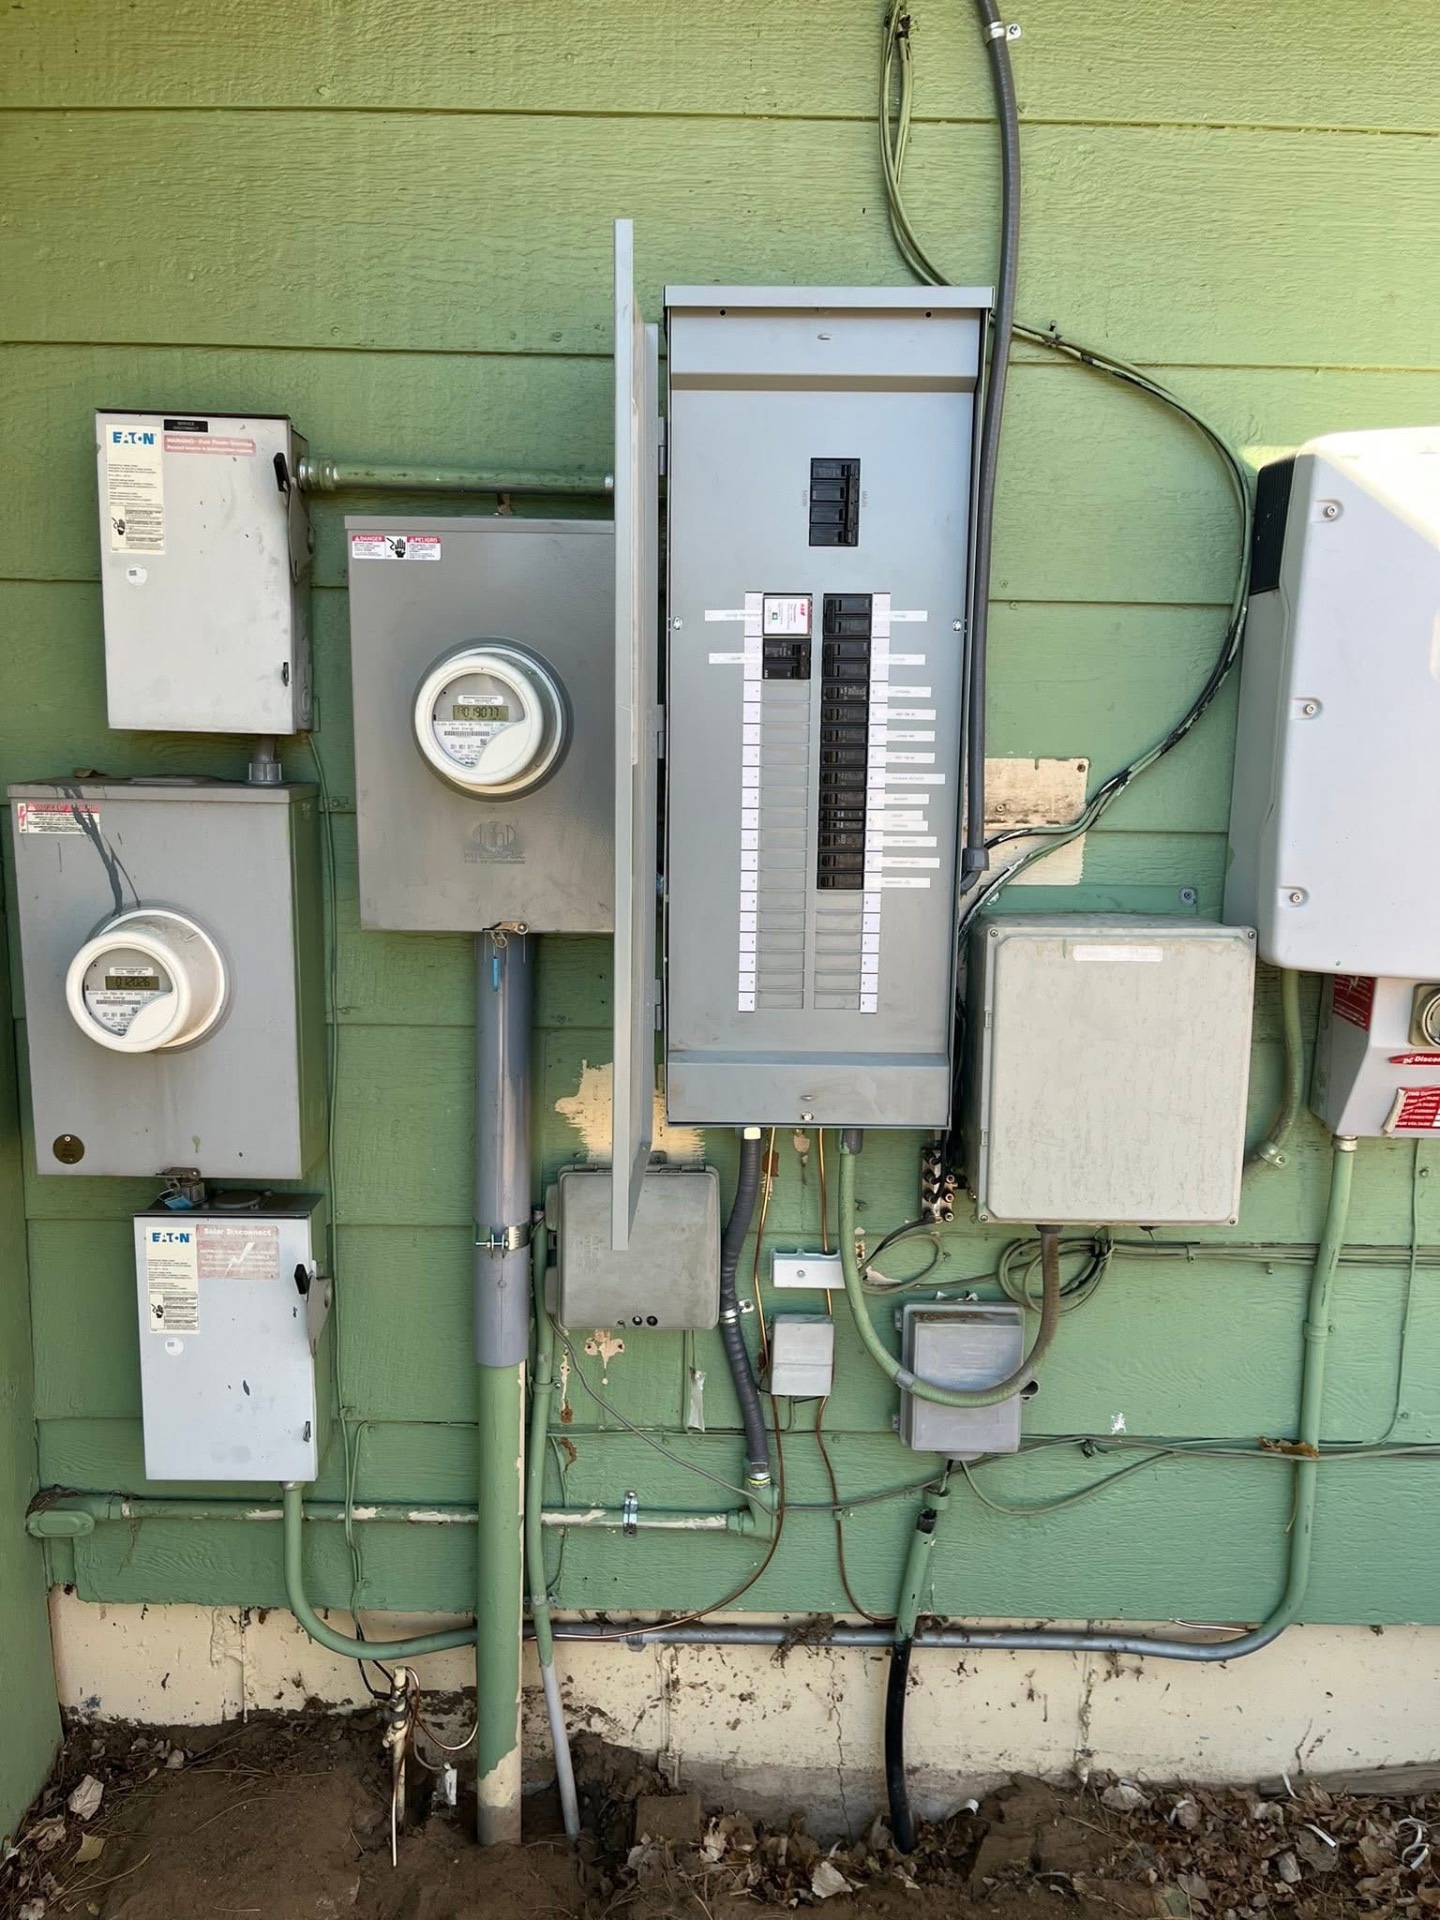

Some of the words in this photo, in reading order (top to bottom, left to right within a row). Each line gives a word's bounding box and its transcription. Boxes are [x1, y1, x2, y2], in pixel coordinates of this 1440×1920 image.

[112, 431, 154, 445] EATON
[152, 1232, 191, 1243] EATON
[203, 1227, 224, 1236] Solar
[226, 1228, 271, 1237] Disconnect
